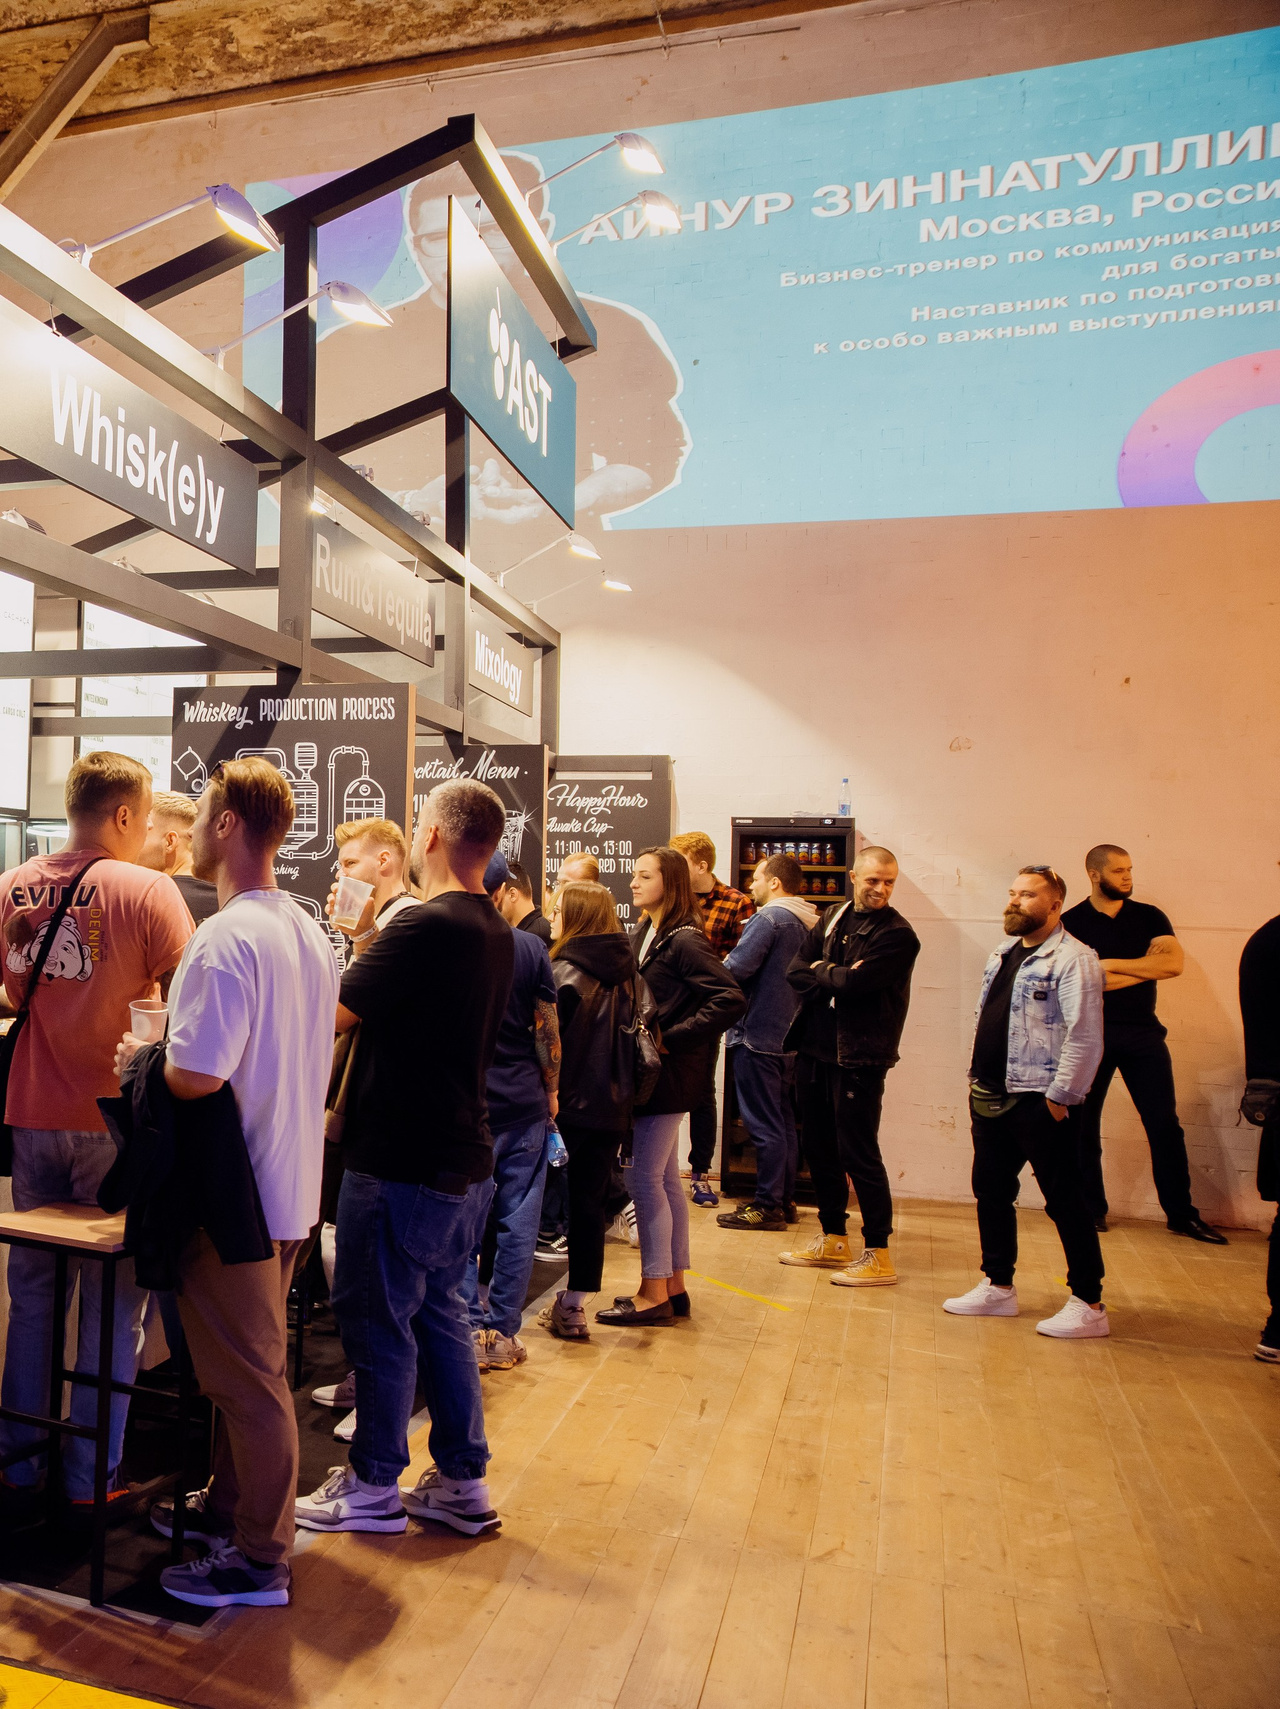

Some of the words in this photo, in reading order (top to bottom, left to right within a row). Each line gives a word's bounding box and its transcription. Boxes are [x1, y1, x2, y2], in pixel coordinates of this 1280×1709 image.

[811, 122, 1280, 218] ЗИННАТУЛЛИ
[920, 204, 1115, 243] Москва,
[780, 253, 997, 288] Бизнес-тренер
[1008, 248, 1044, 265] по
[1101, 260, 1159, 281] для
[911, 294, 1069, 321] Наставник
[1081, 291, 1117, 306] по
[814, 342, 829, 354] к
[839, 332, 927, 352] особо
[937, 322, 1058, 344] важным
[1069, 299, 1280, 331] выступления
[507, 339, 551, 457] AST
[50, 366, 225, 545] Whisk(e)y
[475, 630, 522, 705] Mixology
[183, 701, 253, 730] Whiskey
[260, 698, 336, 721] PRODUCTION
[413, 757, 464, 779] cktail
[460, 750, 520, 781] Menu
[583, 817, 614, 838] Cup
[555, 840, 581, 854] 11:00
[603, 840, 632, 855] 13:00
[273, 864, 299, 880] shing
[88, 908, 102, 961] DENIM
